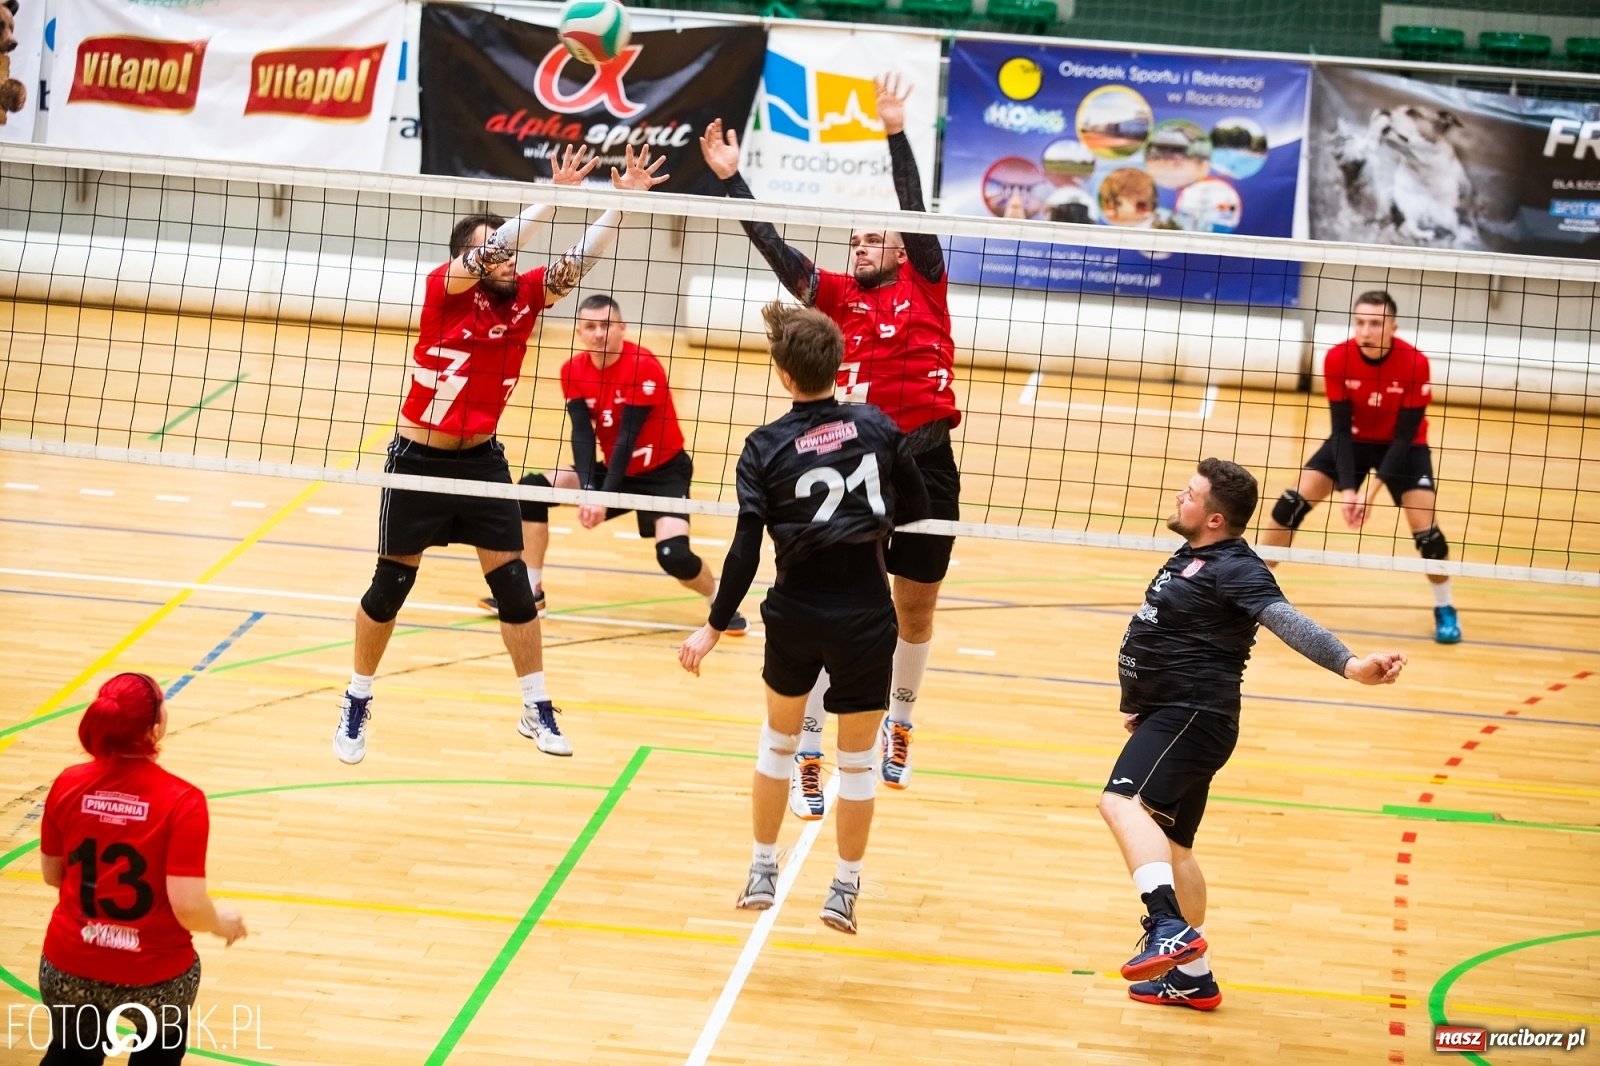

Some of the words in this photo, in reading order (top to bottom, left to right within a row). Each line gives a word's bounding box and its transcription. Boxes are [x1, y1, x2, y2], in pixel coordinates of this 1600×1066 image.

[83, 52, 193, 94] Vitapol
[258, 59, 371, 104] Vitapol
[1128, 65, 1181, 84] Sportu
[1192, 70, 1265, 92] Rekreacji
[1185, 89, 1264, 109] Raciborzu
[485, 109, 583, 141] alpha
[584, 120, 693, 153] spirit
[524, 141, 560, 160] wild
[781, 151, 892, 176] raciborsk
[800, 426, 854, 449] PIWIARNIA
[795, 452, 886, 523] 21
[87, 799, 143, 815] PIWIARNIA
[67, 836, 154, 922] 13
